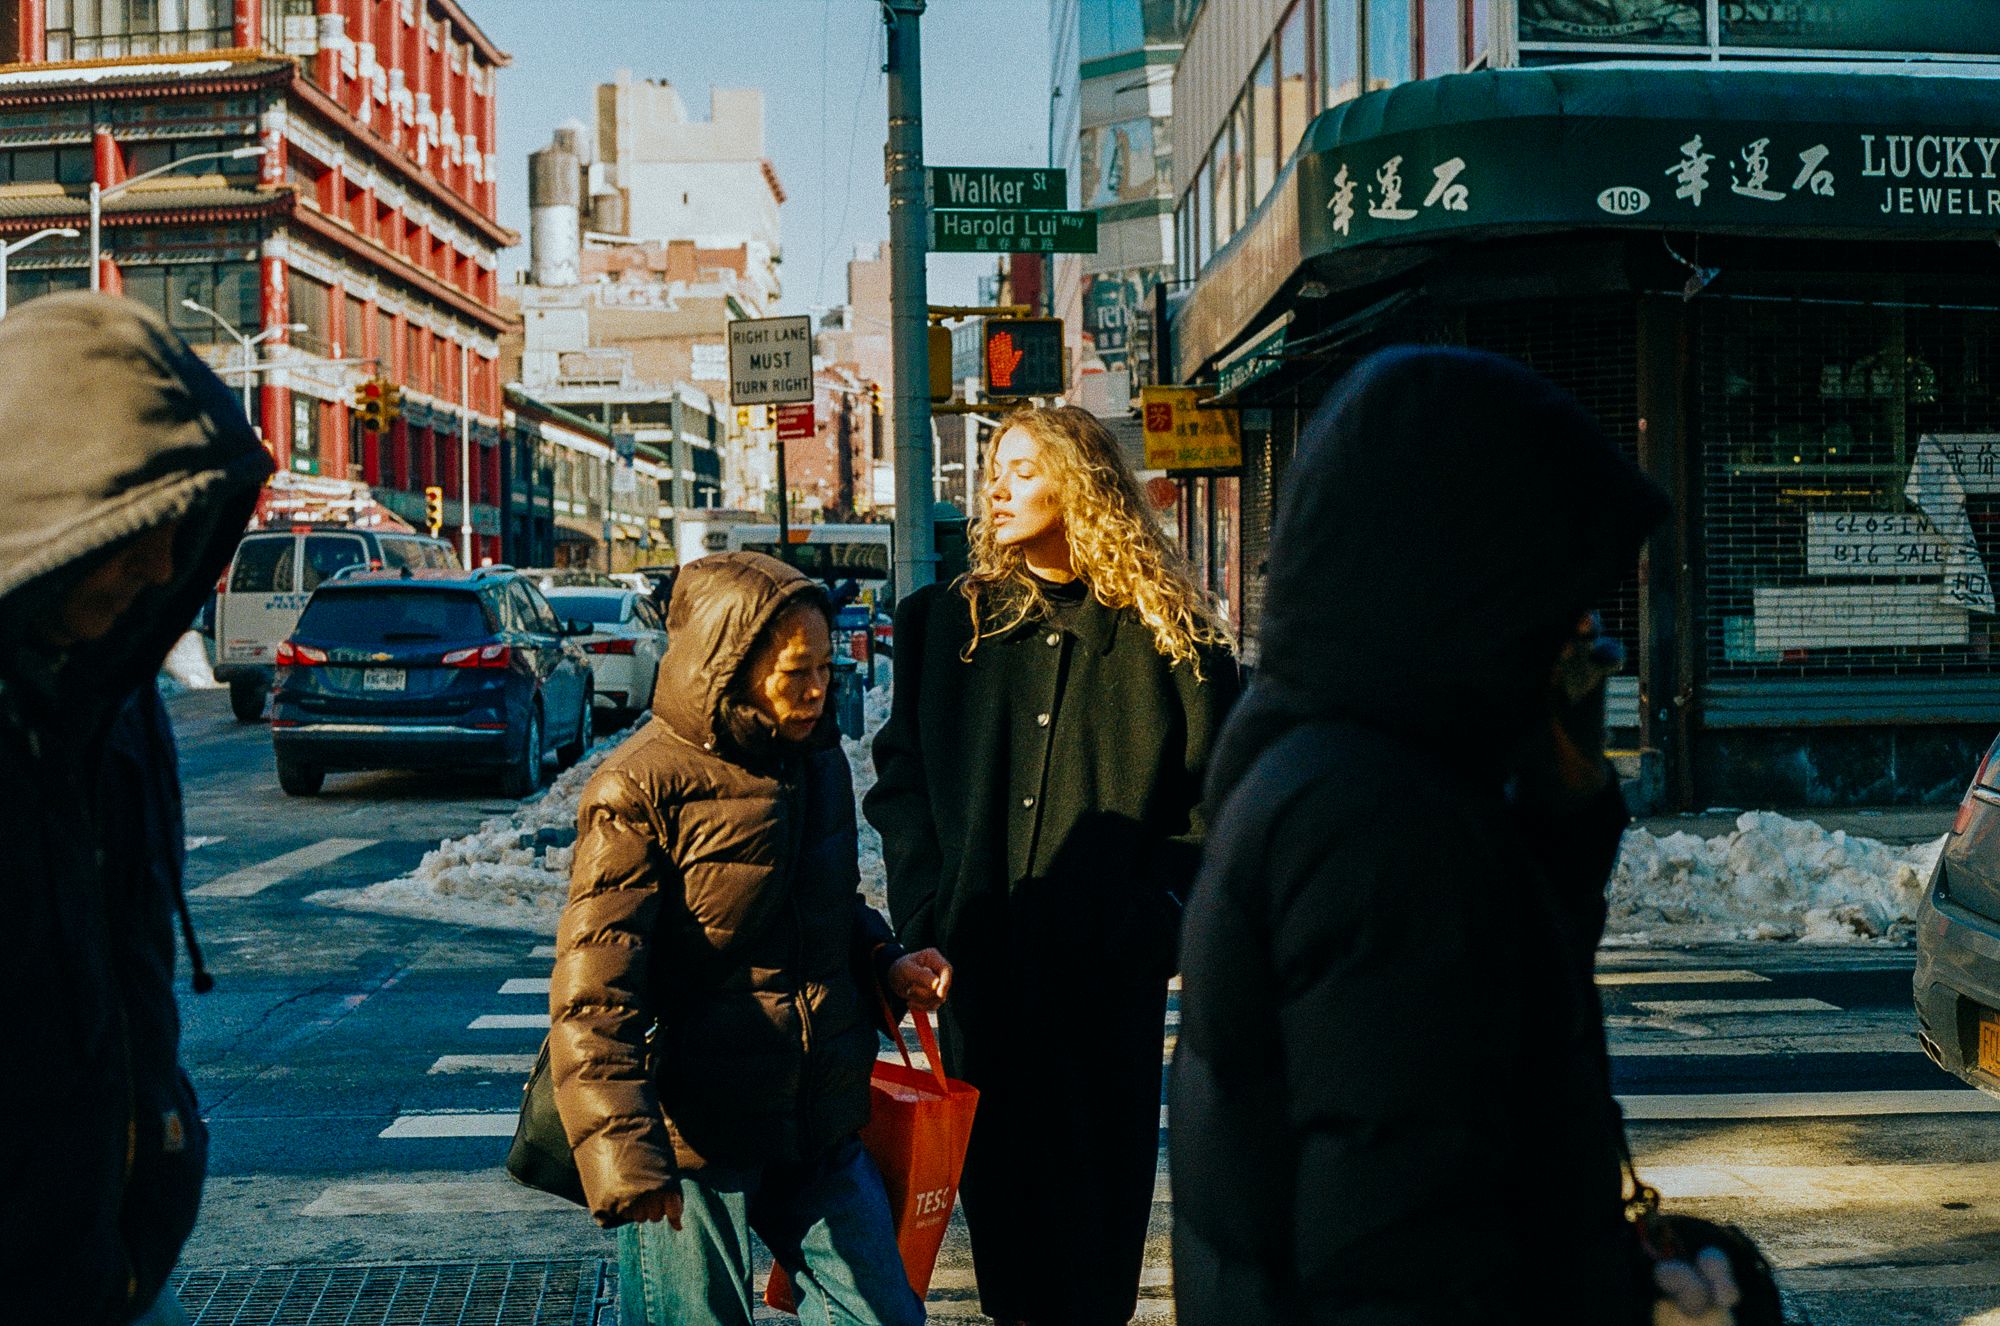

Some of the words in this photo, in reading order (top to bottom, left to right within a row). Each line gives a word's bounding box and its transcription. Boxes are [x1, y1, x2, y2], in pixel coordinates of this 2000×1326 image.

[1860, 134, 2000, 178] LUCKY
[948, 173, 1025, 204] Walker
[1032, 171, 1047, 191] St
[1607, 191, 1641, 211] 109
[1880, 187, 2000, 214] JEWELR
[943, 214, 1015, 236] Harold
[1024, 214, 1057, 236] Lui
[1061, 215, 1084, 228] Way
[733, 330, 769, 344] RIGHT
[774, 327, 806, 342] LANE
[749, 351, 791, 370] MUST
[735, 381, 768, 394] TURN
[772, 377, 809, 392] RIGHT
[1835, 514, 1930, 536] CLOSIN
[1834, 545, 1879, 563] BIG
[1895, 544, 1945, 563] SALE
